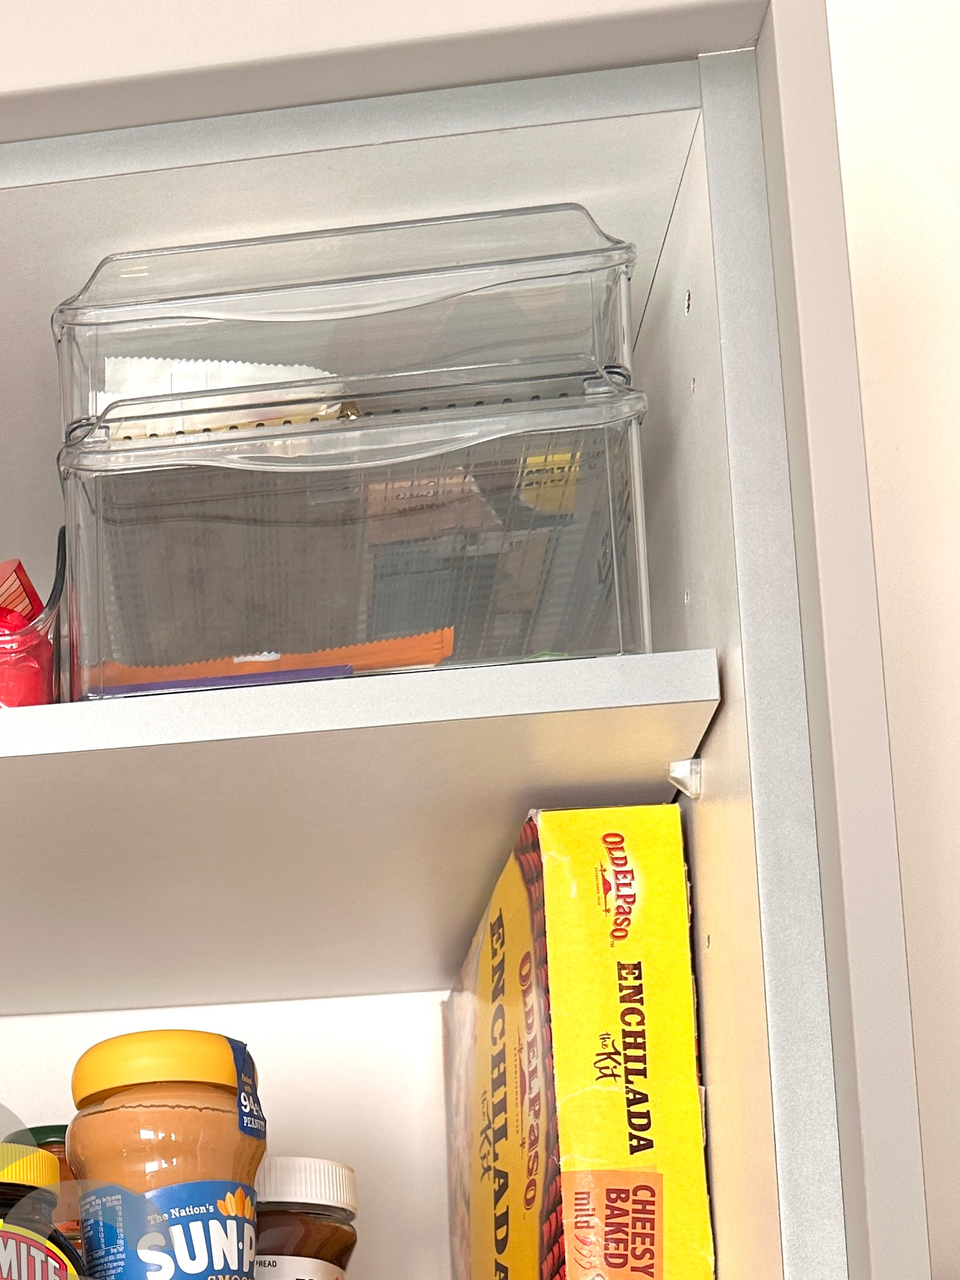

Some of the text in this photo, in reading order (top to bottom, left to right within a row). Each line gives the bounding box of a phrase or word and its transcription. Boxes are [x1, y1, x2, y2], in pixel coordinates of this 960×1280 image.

[593, 1037, 622, 1083] Kit
[616, 961, 655, 1156] ENCHILADA
[147, 1203, 214, 1225] The Nation's
[574, 1191, 593, 1231] mild
[604, 1188, 630, 1270] BAKED
[630, 1184, 656, 1279] CHEESY
